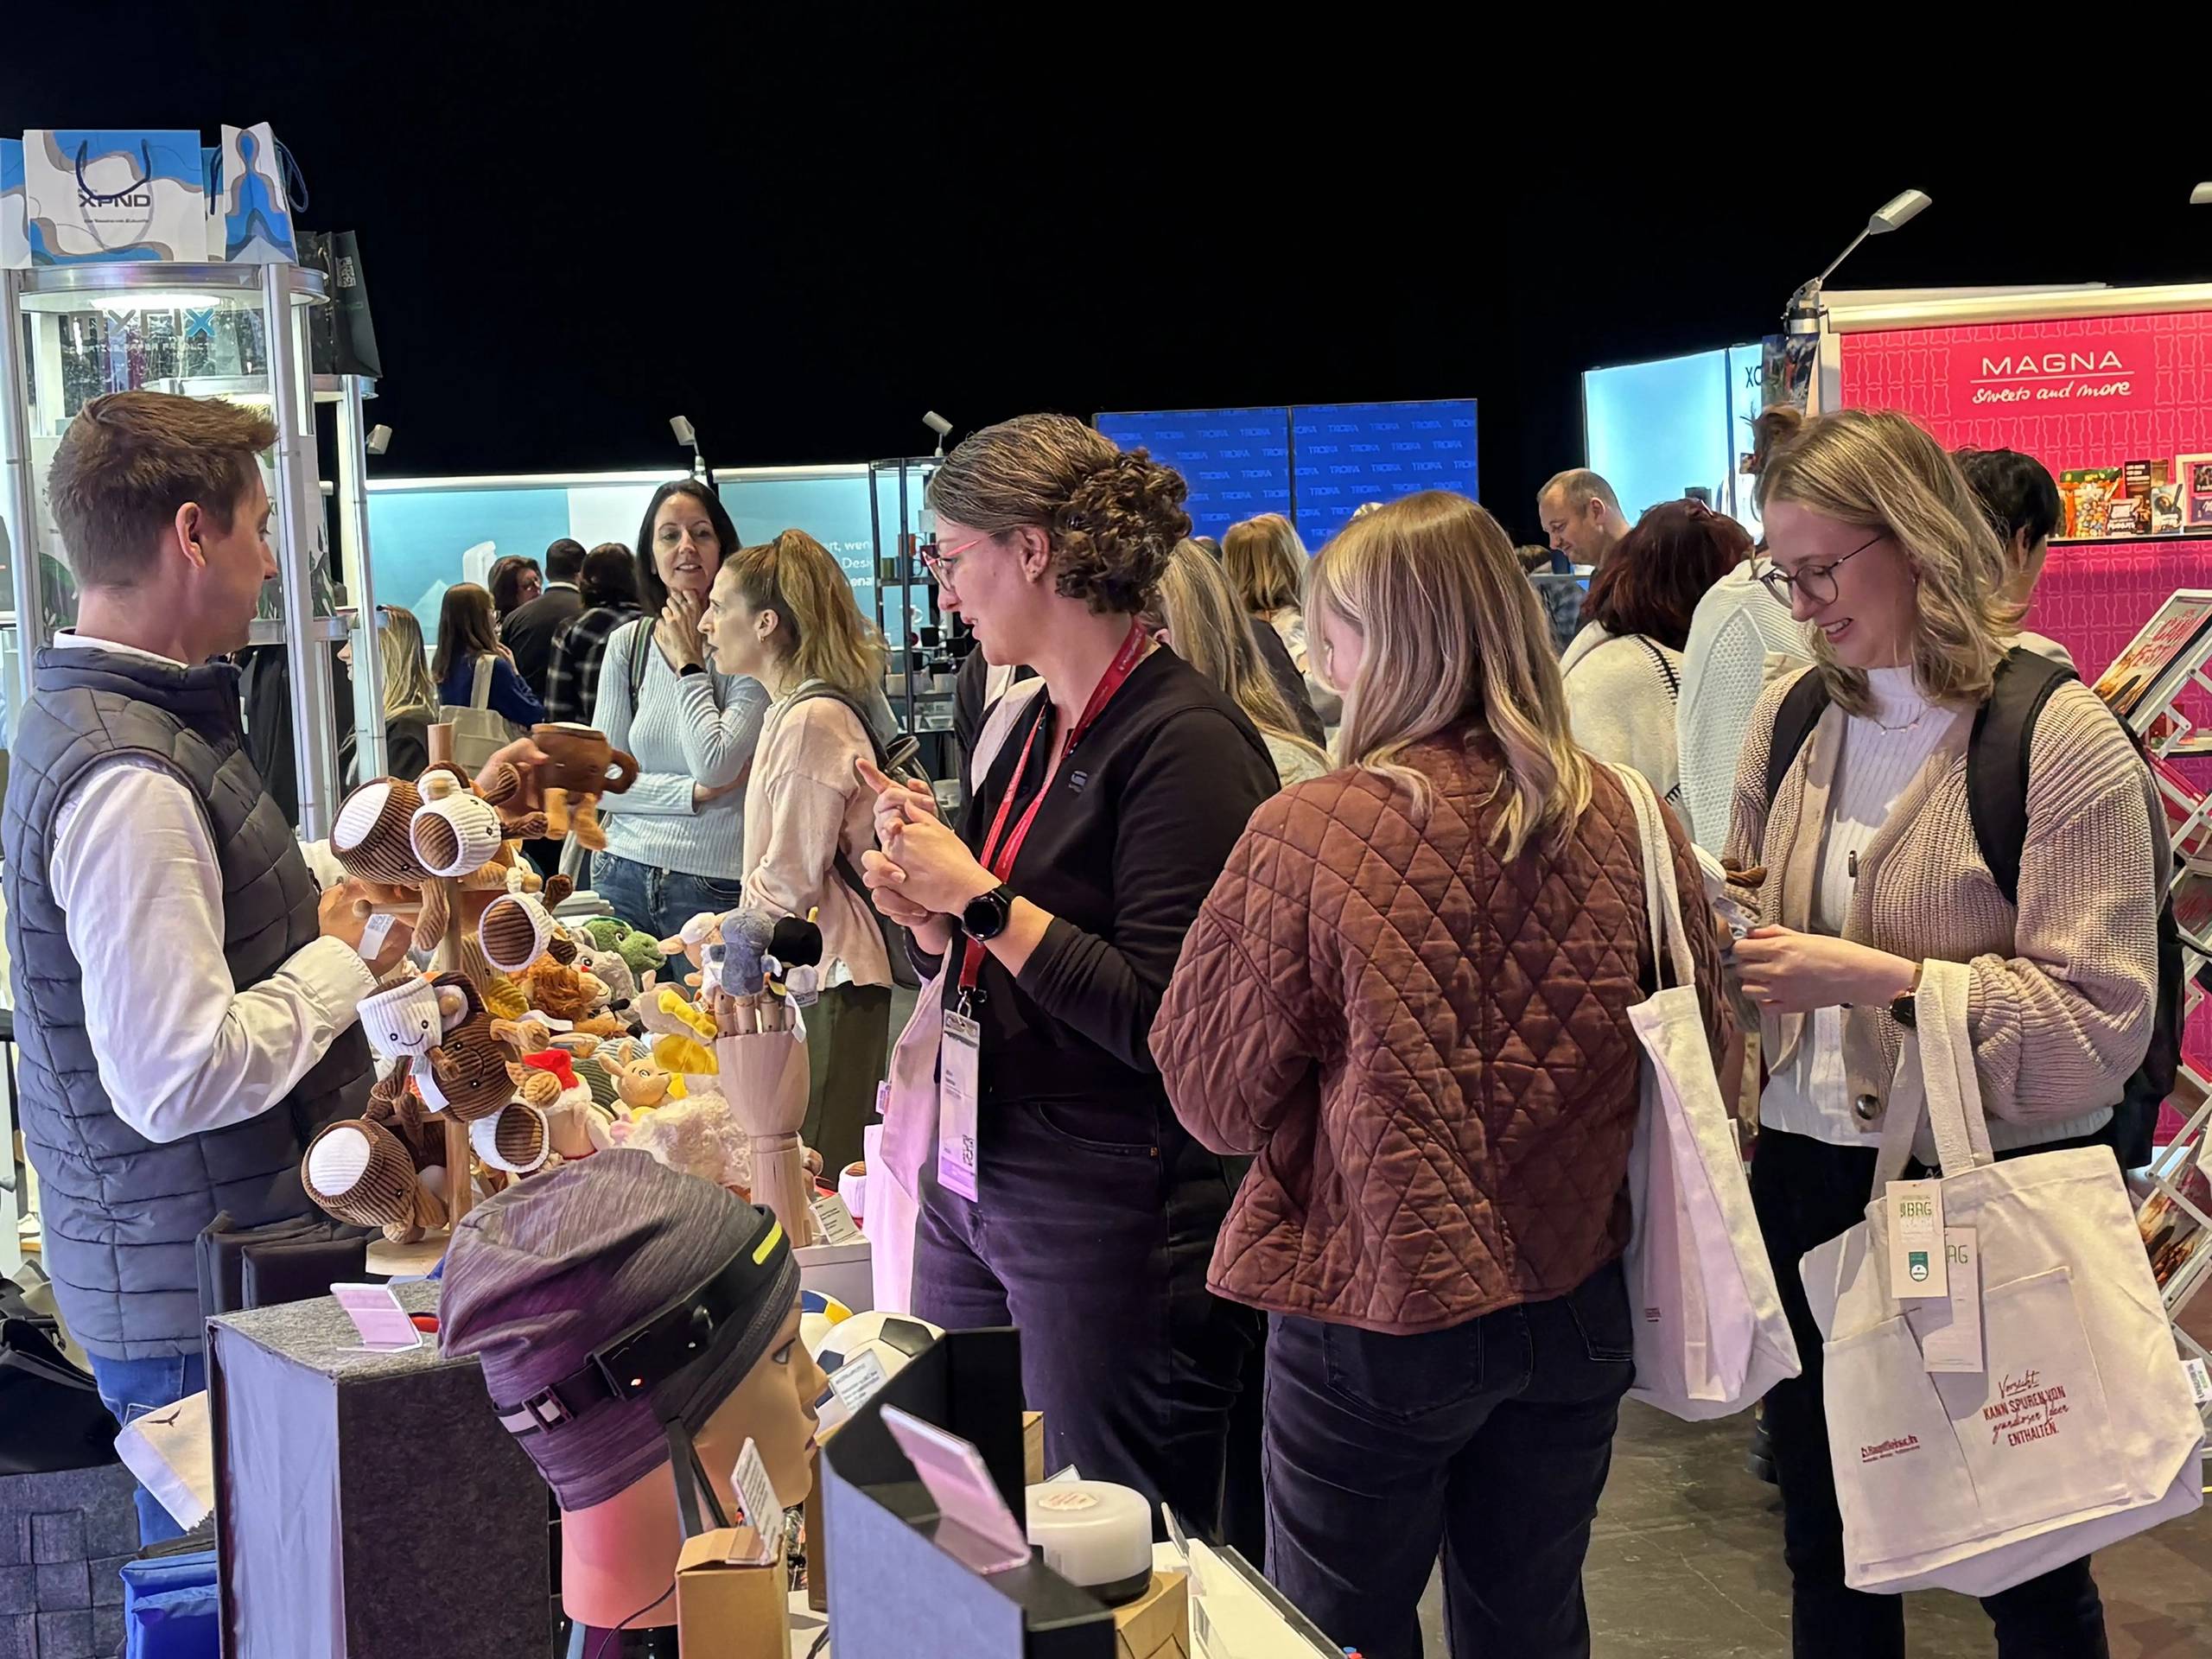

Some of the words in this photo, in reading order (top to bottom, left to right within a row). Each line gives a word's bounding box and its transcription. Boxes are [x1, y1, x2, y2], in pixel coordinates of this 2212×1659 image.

[78, 194, 150, 207] XPND
[1982, 351, 2123, 377] MAGNA
[1972, 386, 2031, 404] sweets
[2037, 380, 2075, 400] and
[2076, 381, 2133, 398] more
[844, 541, 871, 550] wen
[1982, 1402, 2010, 1421] KANN
[2008, 1390, 2046, 1414] SPUREN
[2044, 1386, 2066, 1402] VON
